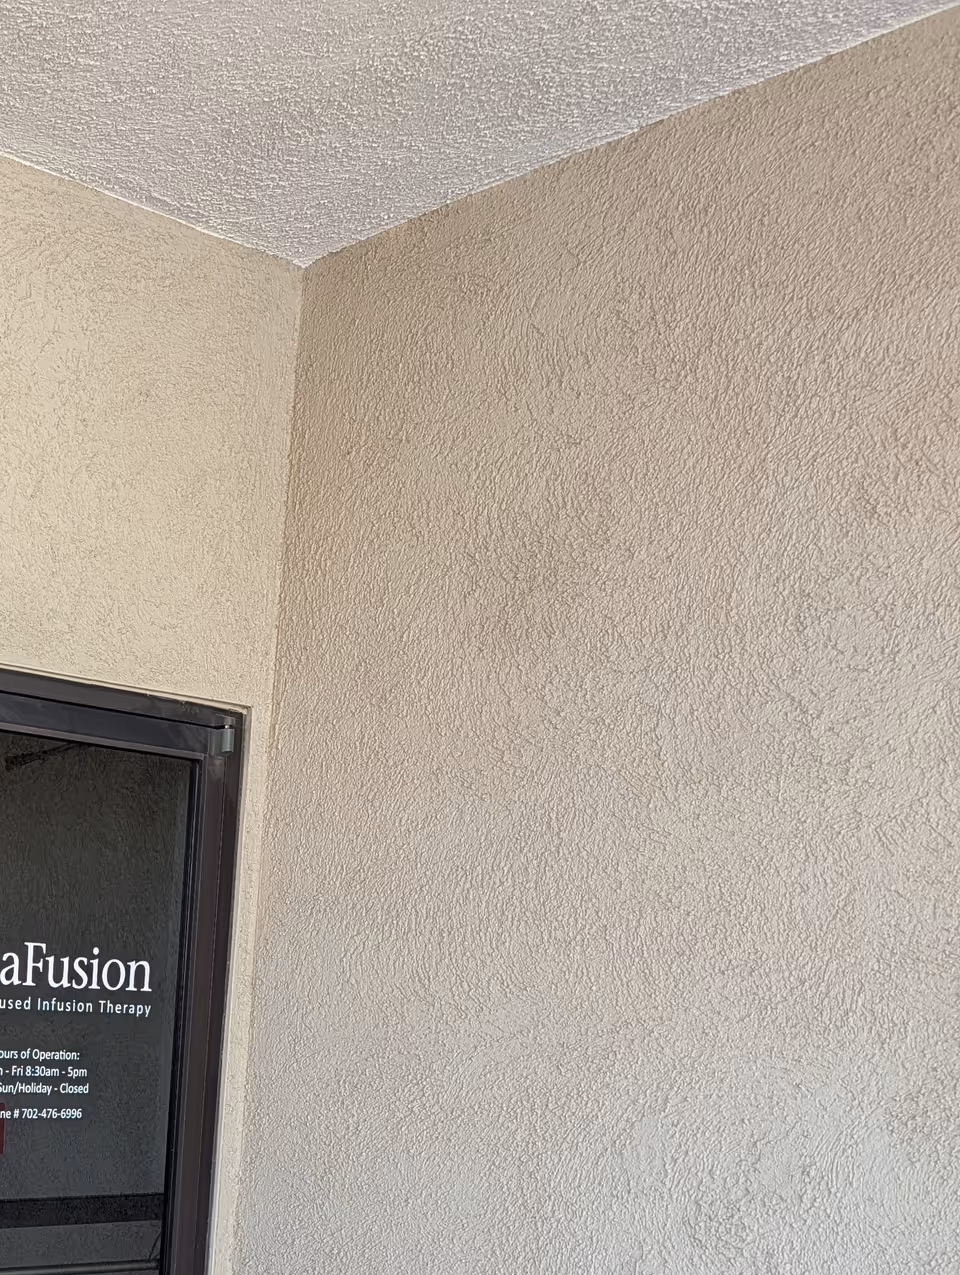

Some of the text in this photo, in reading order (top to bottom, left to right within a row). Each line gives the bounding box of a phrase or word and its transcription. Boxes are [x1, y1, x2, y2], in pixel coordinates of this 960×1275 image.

[37, 997, 93, 1012] Infusion
[98, 1000, 152, 1018] Therapy
[20, 1048, 31, 1059] of
[32, 1048, 80, 1062] Operation:
[11, 1065, 24, 1076] Fri
[25, 1066, 60, 1077] 8:30am
[67, 1066, 88, 1079] 5pm
[59, 1082, 89, 1094] Closed
[13, 1109, 20, 1118] #
[21, 1108, 83, 1119] 702-476-6996
